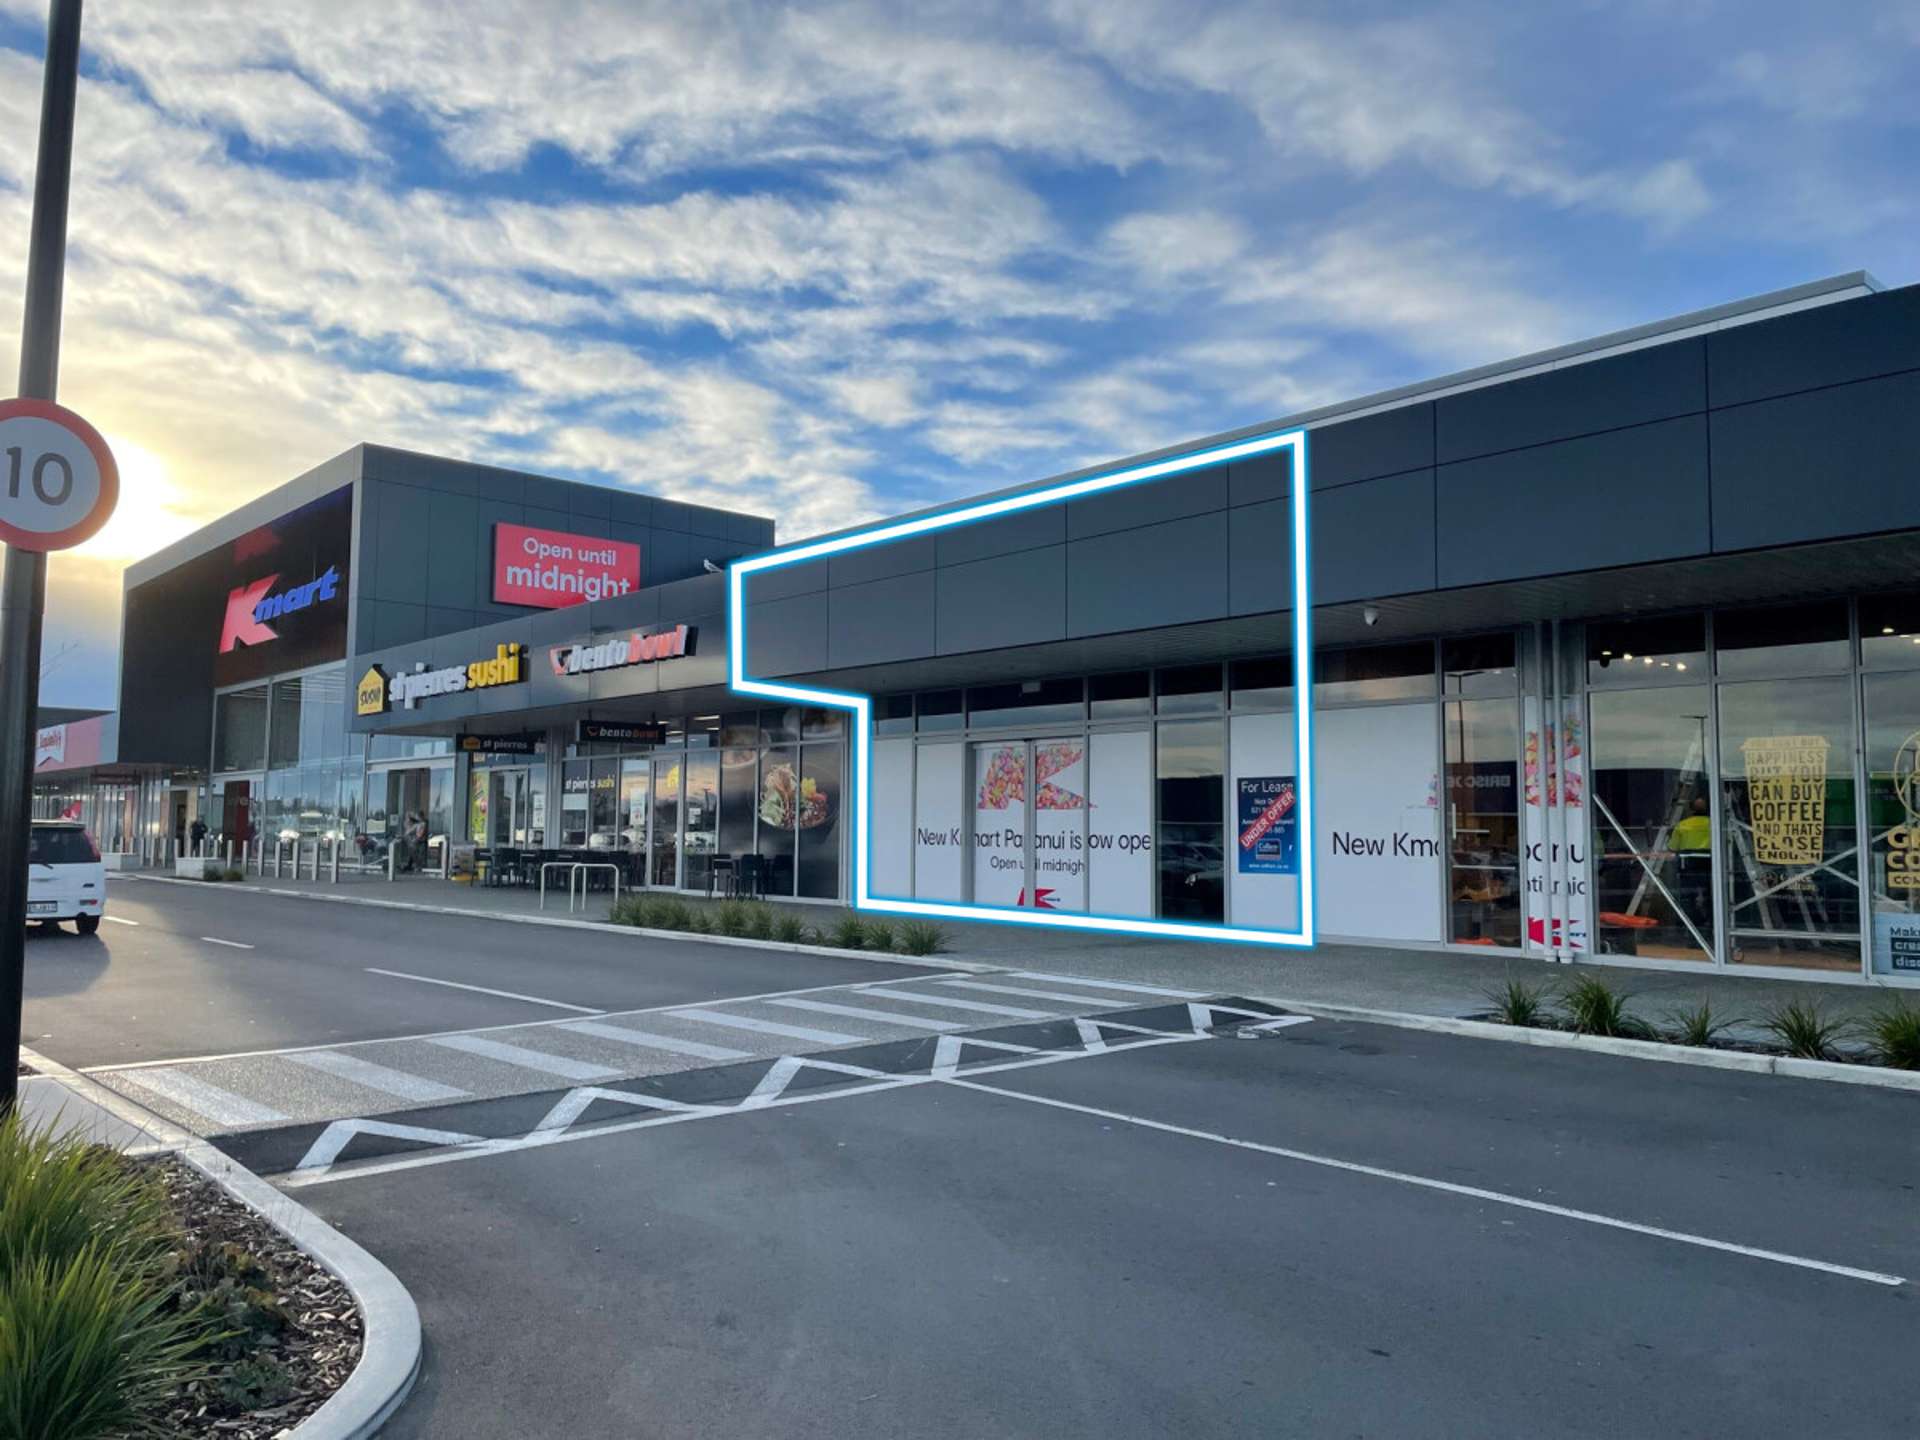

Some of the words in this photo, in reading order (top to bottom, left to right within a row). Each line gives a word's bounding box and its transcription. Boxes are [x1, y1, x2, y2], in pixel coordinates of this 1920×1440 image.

[7, 446, 73, 505] 10
[523, 537, 573, 561] Open
[578, 545, 617, 567] until
[506, 563, 631, 600] midnight
[219, 565, 341, 653] Kmart
[467, 642, 519, 689] sushi
[1747, 750, 1824, 765] HAPPINESS
[1750, 766, 1781, 783] BUT
[1790, 766, 1823, 783] YOU
[1241, 781, 1260, 793] For
[1262, 781, 1294, 793] Lease
[1750, 784, 1783, 801] CAN
[1791, 784, 1823, 800] BUY
[1241, 818, 1270, 848] UNDER
[1267, 790, 1295, 820] OFFER
[1753, 802, 1823, 821] COFFEE
[917, 827, 947, 846] New
[1069, 831, 1082, 850] is
[1756, 823, 1780, 835] AND
[1784, 823, 1822, 836] THATS
[1332, 832, 1385, 856] New
[1757, 836, 1821, 850] CLOSE
[990, 856, 1017, 871] Open
[1043, 858, 1085, 876] midnigh
